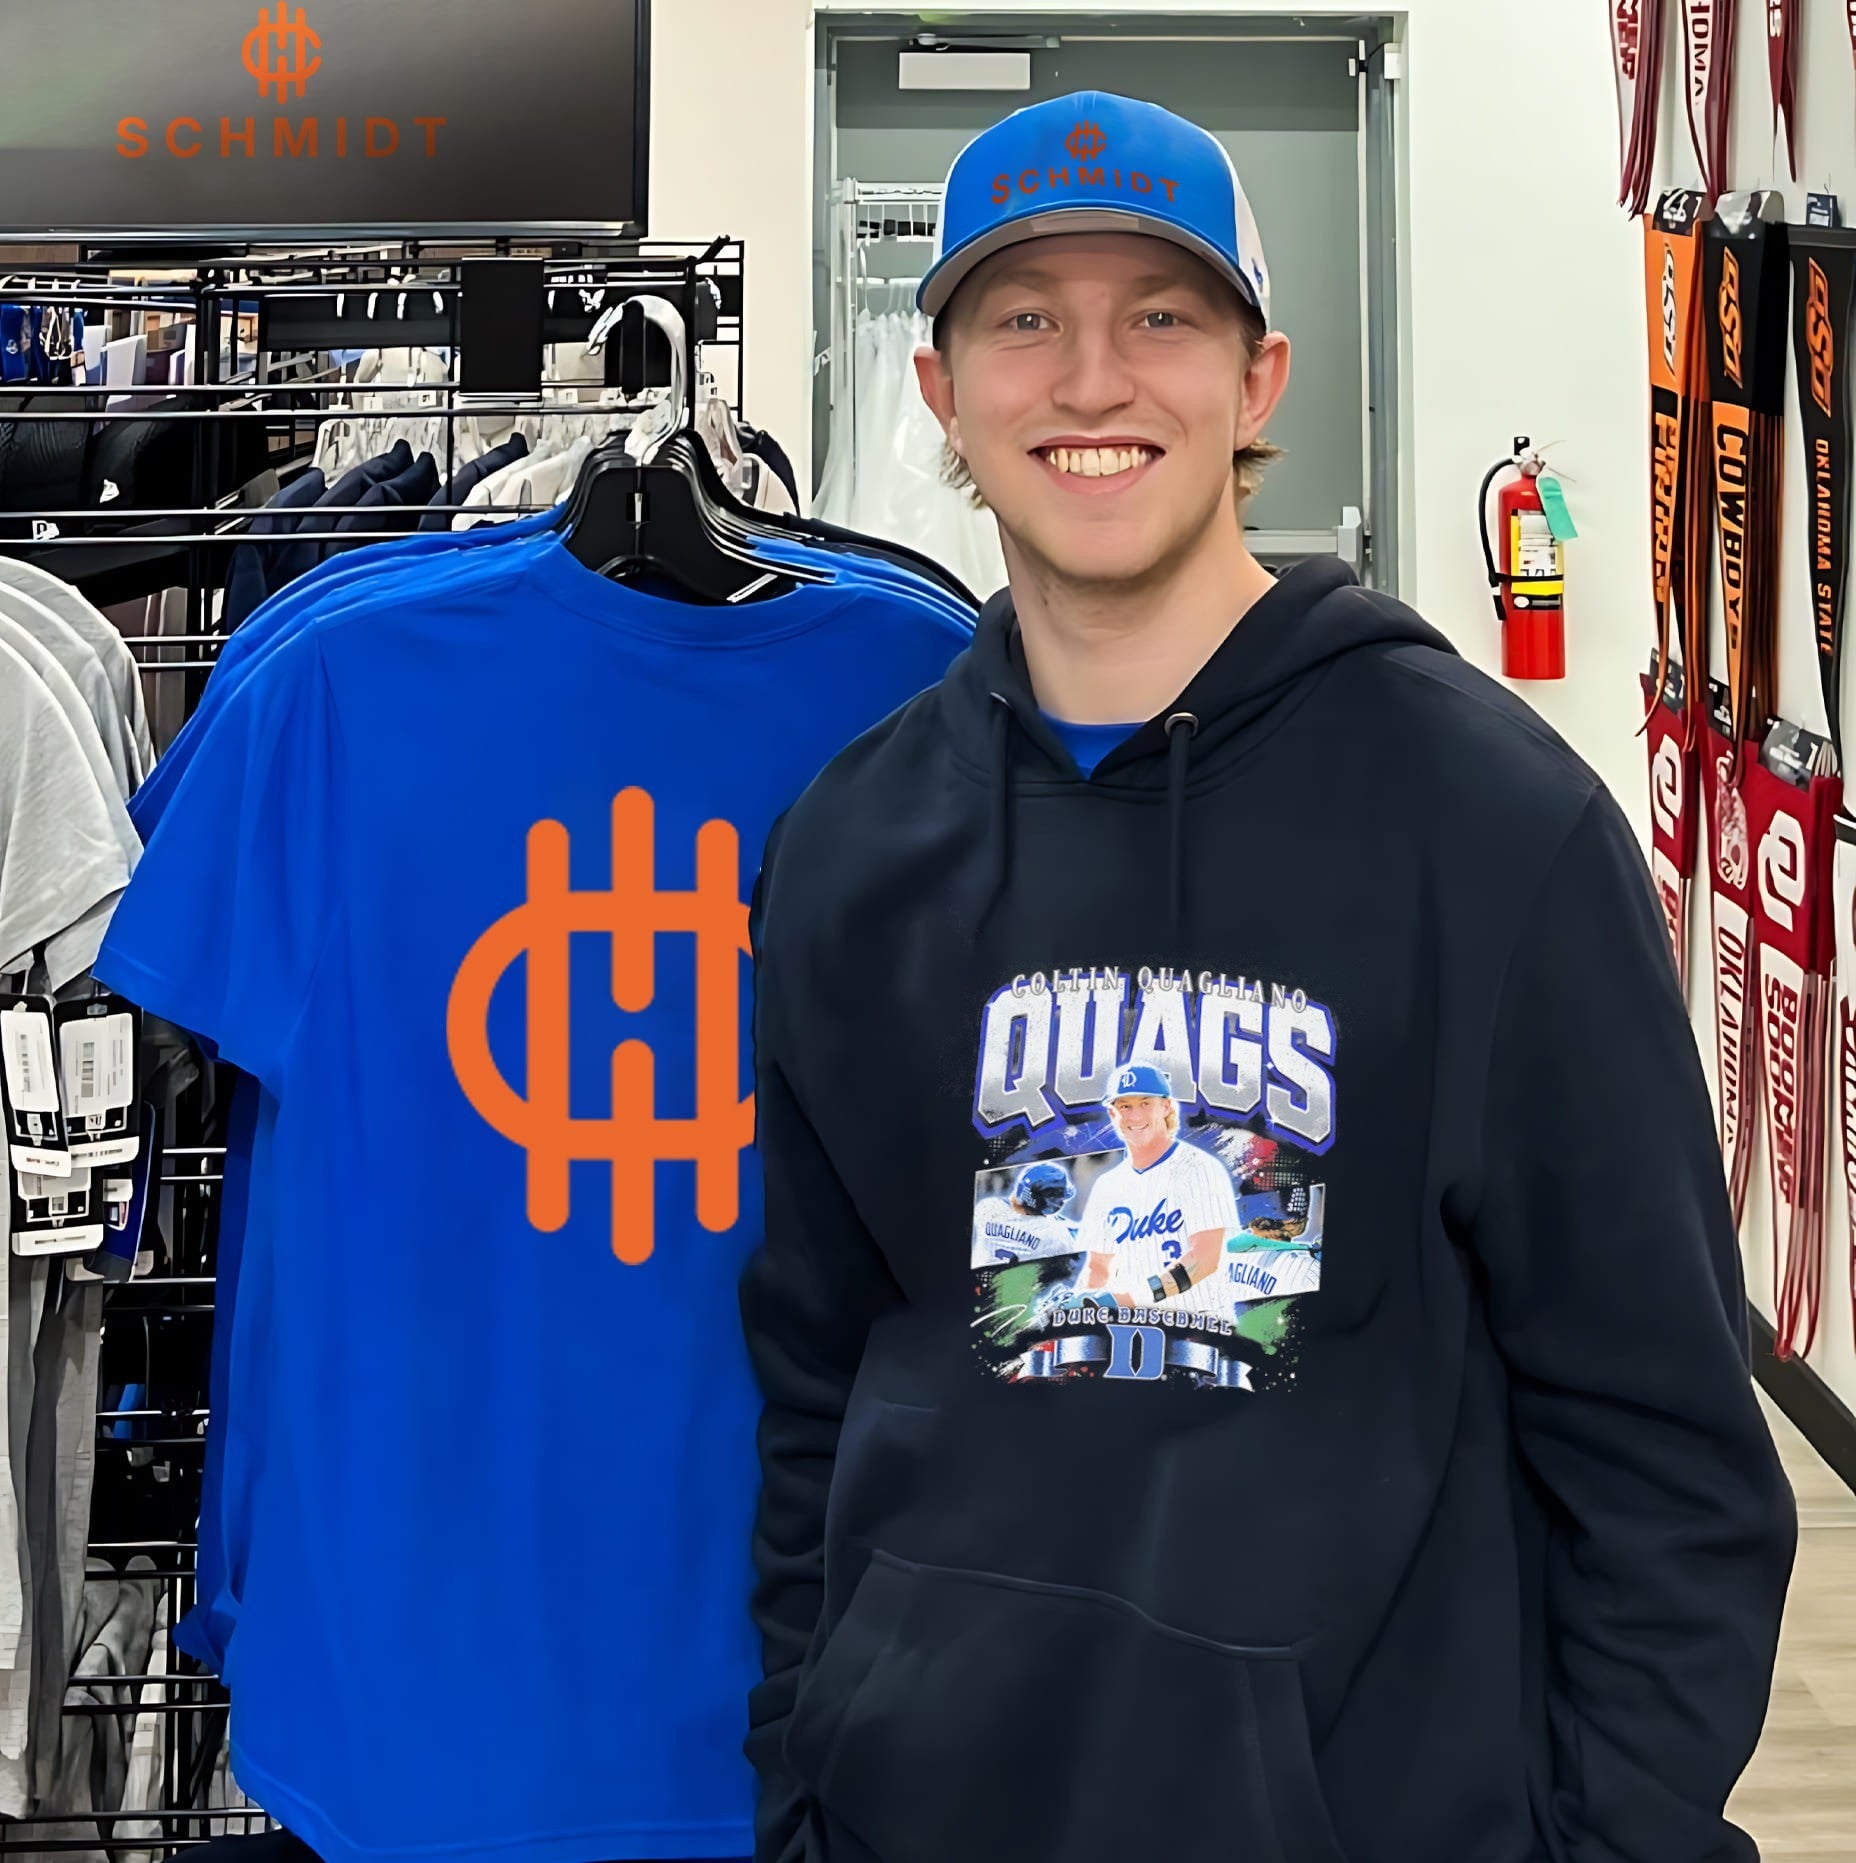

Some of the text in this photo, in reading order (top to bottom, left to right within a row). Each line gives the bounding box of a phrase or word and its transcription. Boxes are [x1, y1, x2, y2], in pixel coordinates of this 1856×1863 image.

[115, 117, 448, 159] SCHMIDT
[991, 167, 1179, 205] SCHMIDT
[1815, 438, 1832, 571] OKLAHOMA
[1010, 965, 1308, 1014] COLTIN QUAGLIANO
[974, 974, 1336, 1150] QUAGS
[985, 1222, 1041, 1251] QUAGLIANO
[1107, 1197, 1185, 1244] Duke
[1117, 1306, 1234, 1337] BASEBALL
